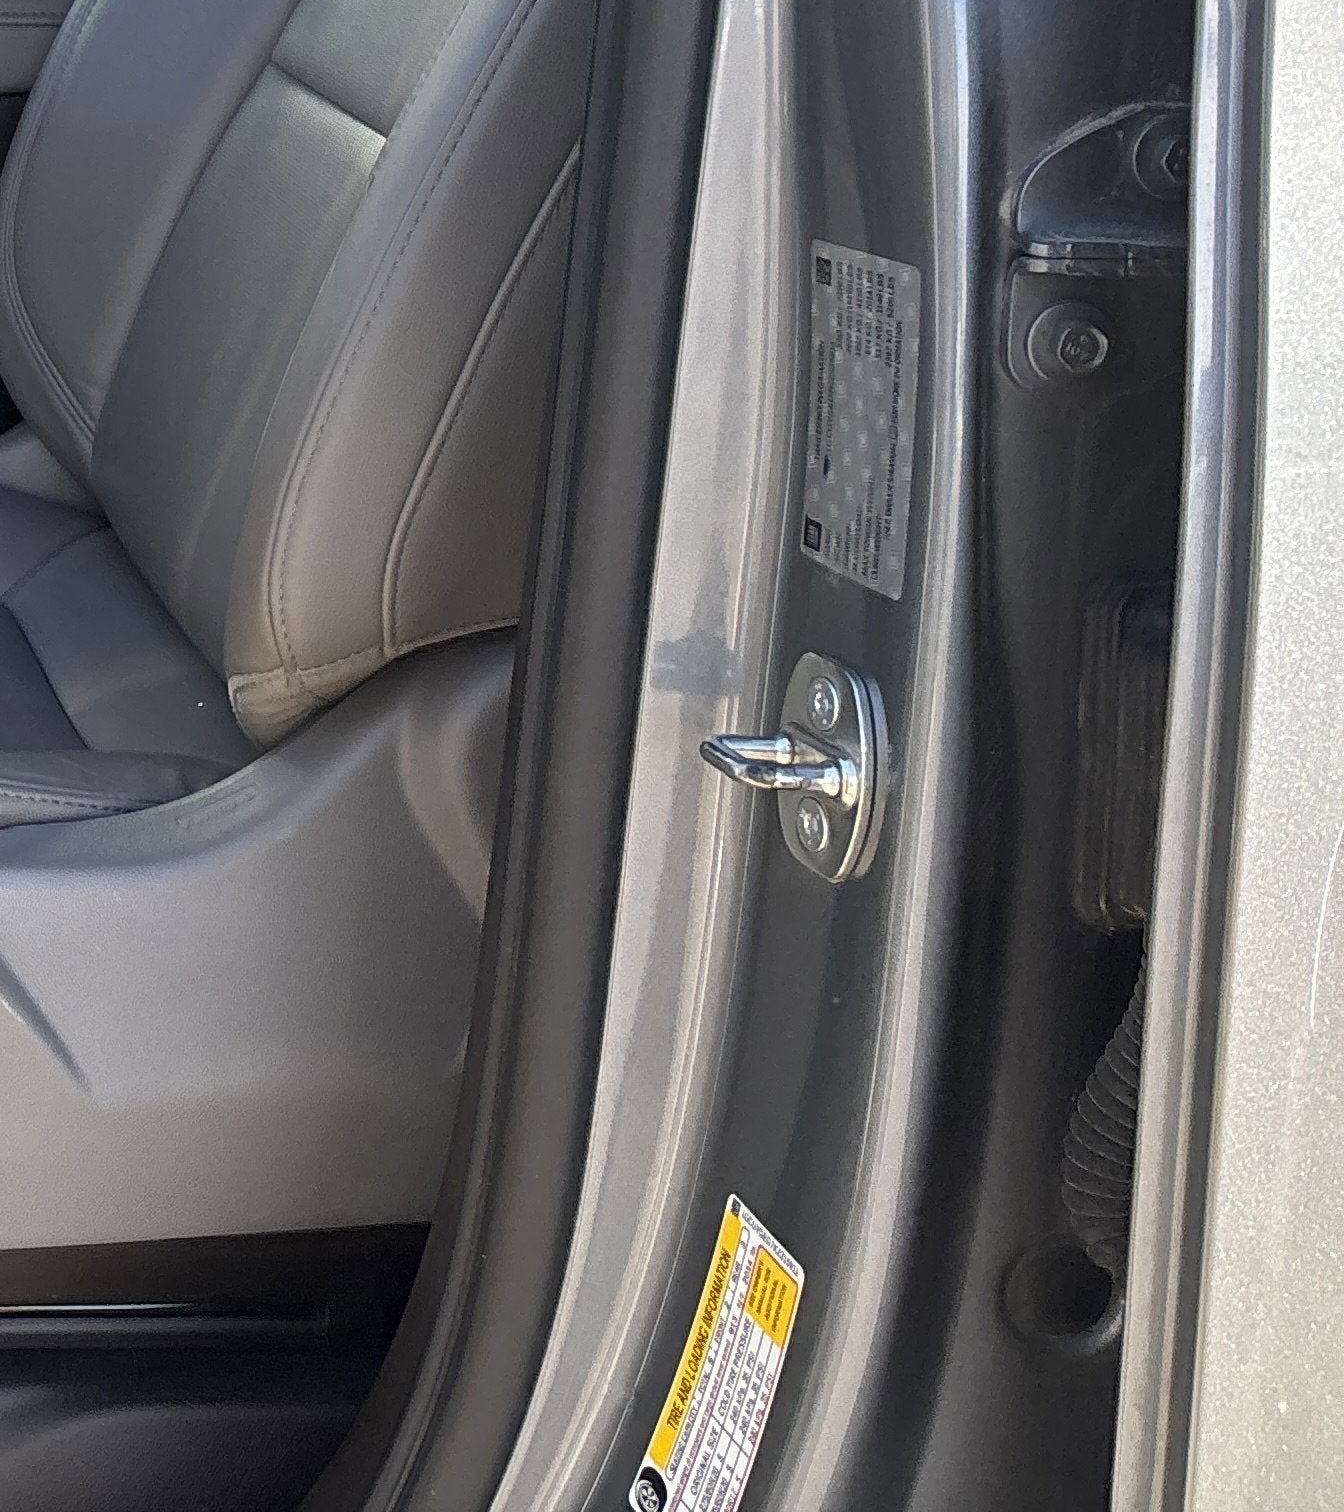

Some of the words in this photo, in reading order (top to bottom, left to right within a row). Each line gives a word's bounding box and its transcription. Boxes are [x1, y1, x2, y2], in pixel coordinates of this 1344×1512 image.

[667, 1402, 683, 1430] TIRE
[676, 1378, 692, 1405] AND
[685, 1330, 708, 1380] LOADING
[702, 1247, 731, 1328] INFORMATION
[718, 1390, 730, 1416] COLD
[724, 1367, 737, 1388] TIRE
[733, 1317, 751, 1367] PRESSURE
[691, 1452, 710, 1496] ORIGINAL
[707, 1426, 719, 1449] SIZE
